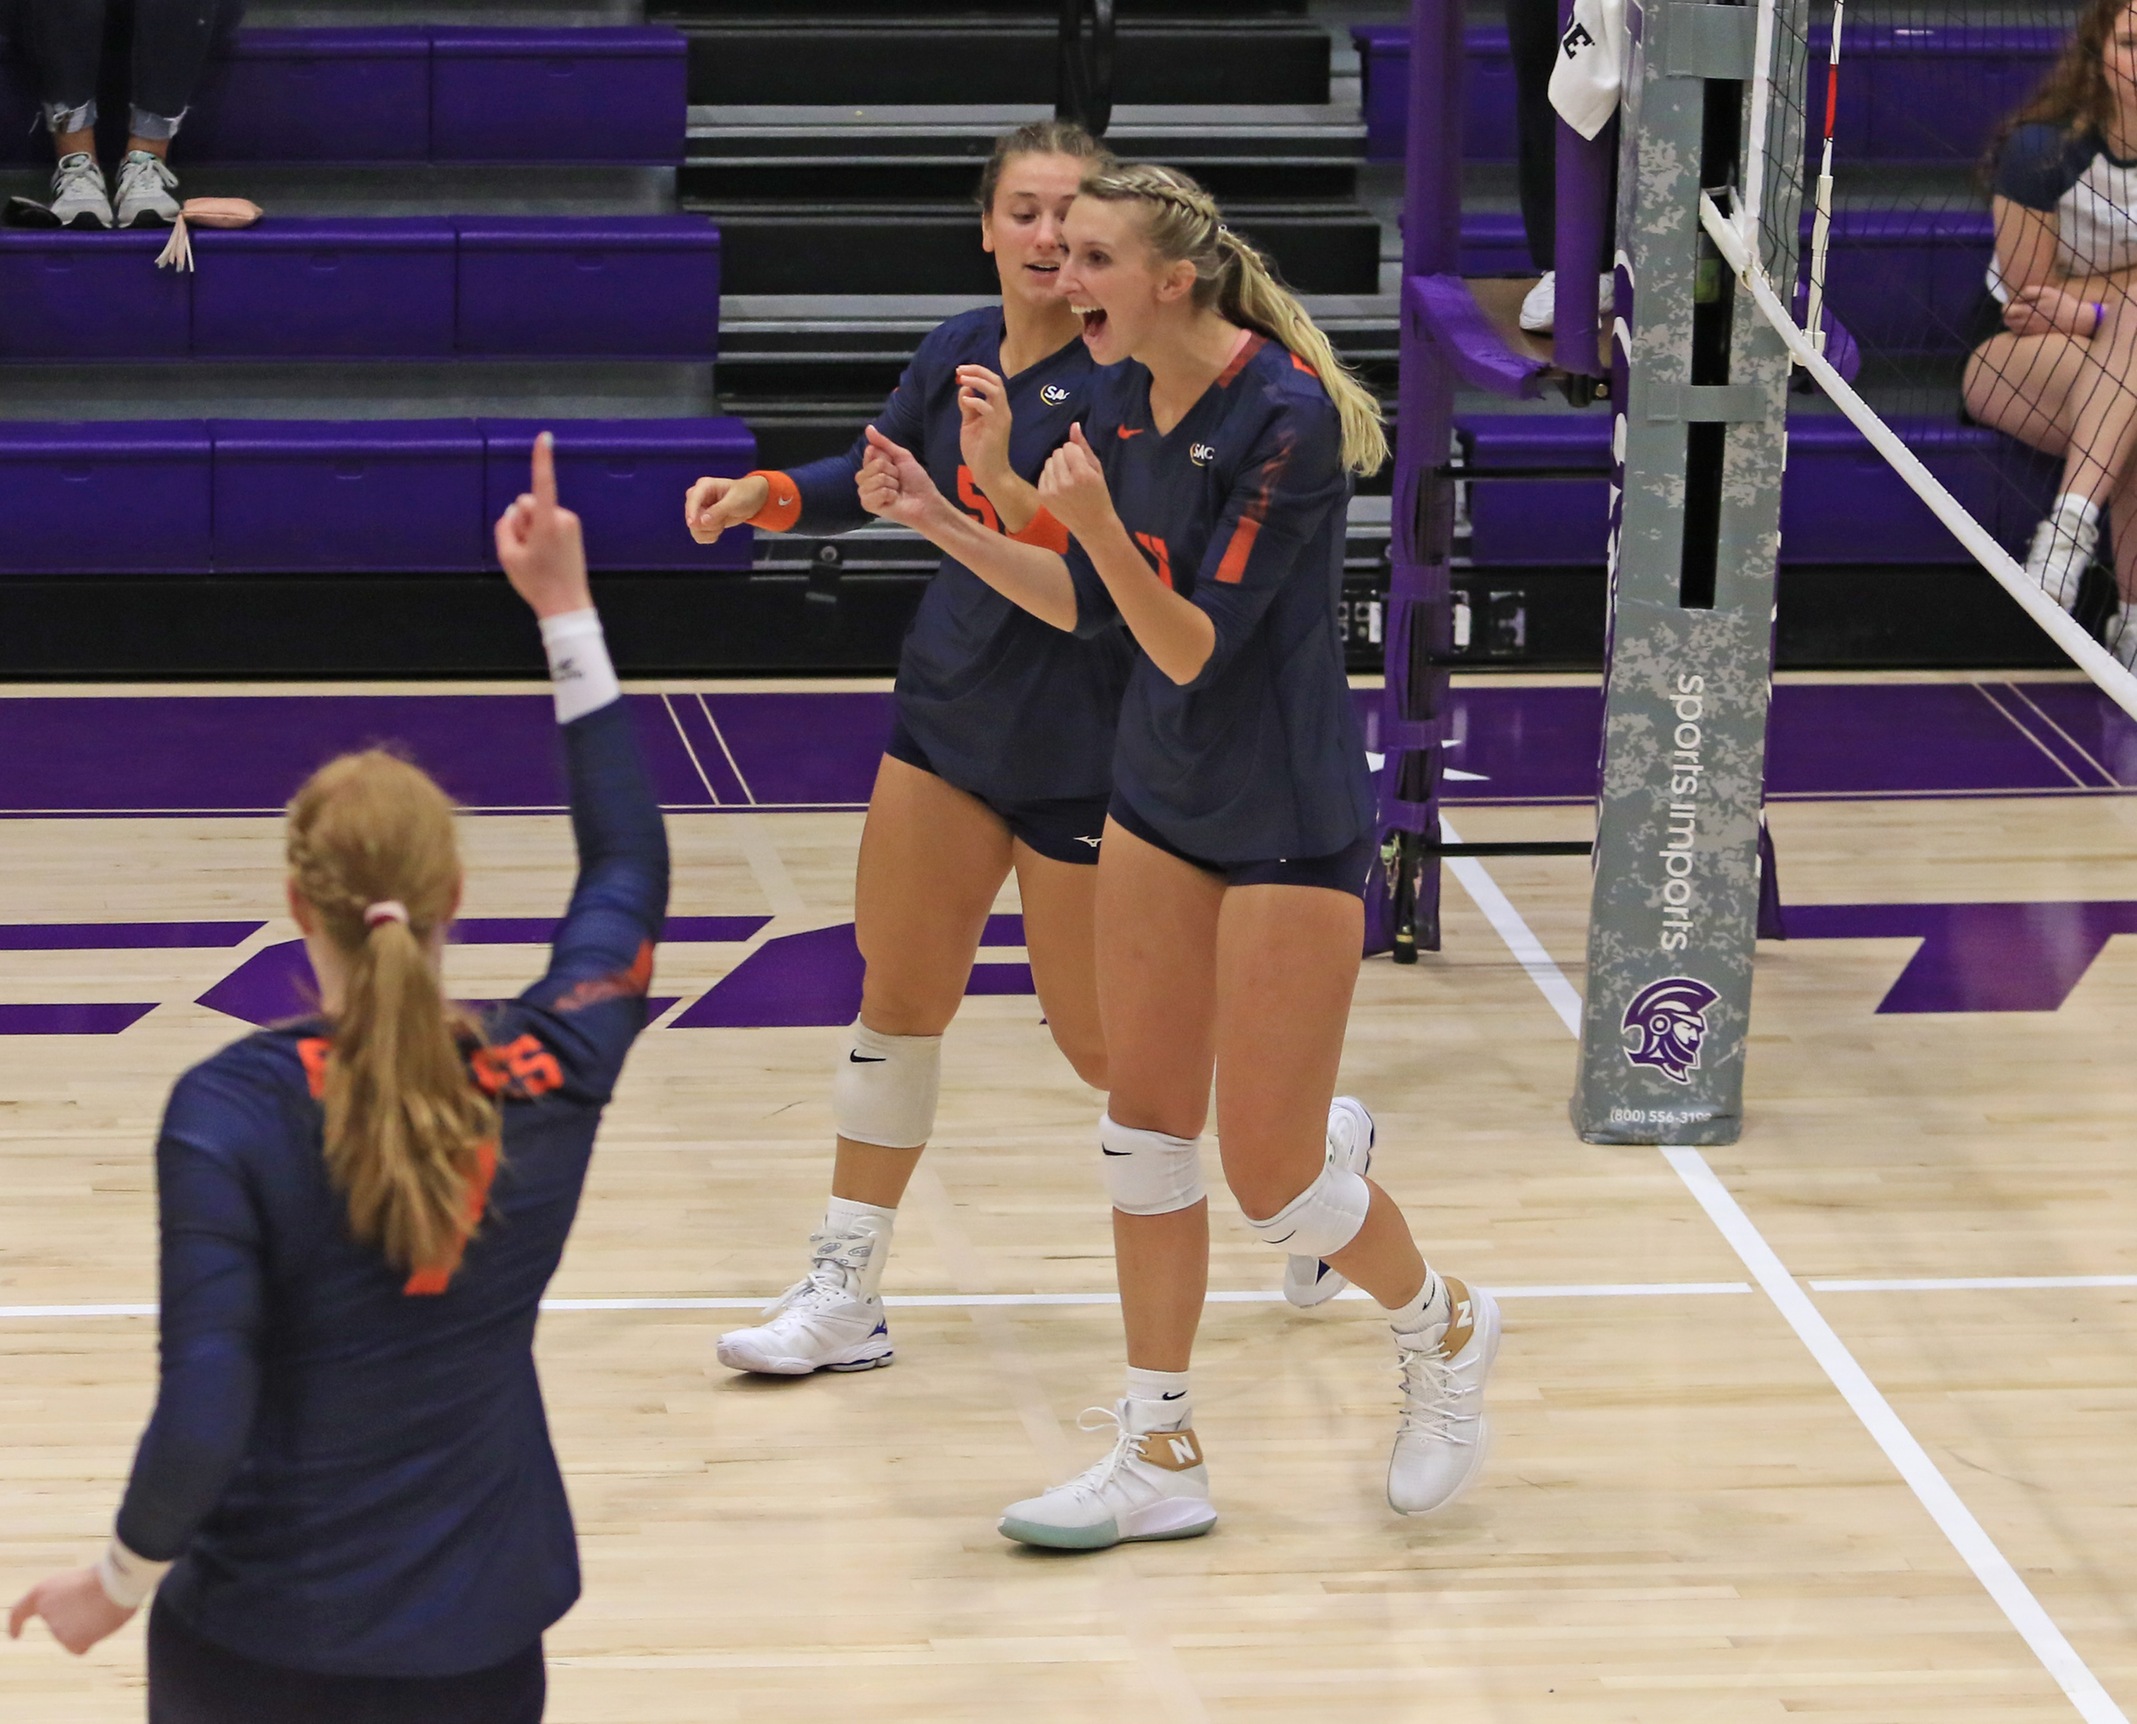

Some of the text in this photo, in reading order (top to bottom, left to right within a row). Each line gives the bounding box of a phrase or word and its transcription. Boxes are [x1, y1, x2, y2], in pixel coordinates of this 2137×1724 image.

[1192, 443, 1215, 460] SAC
[1659, 673, 1705, 951] sports imports
[1610, 1108, 1646, 1124] (800)
[1167, 1435, 1197, 1465] N
